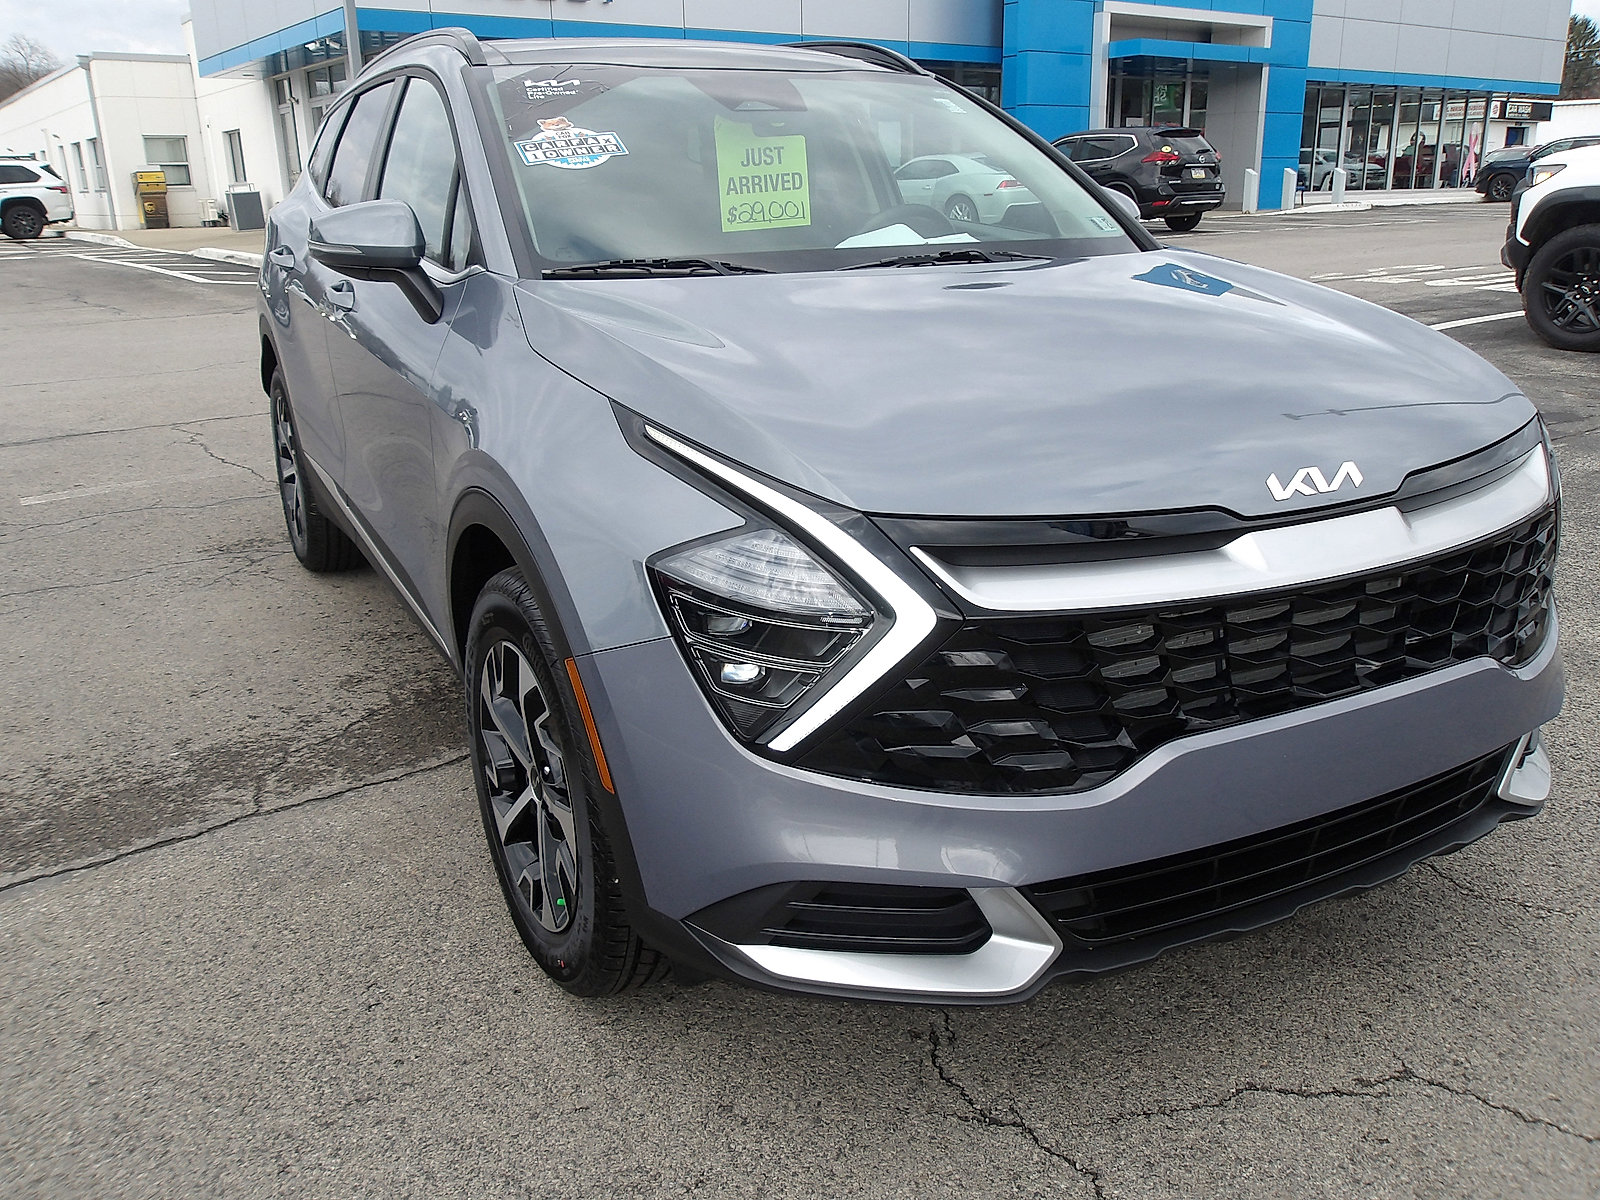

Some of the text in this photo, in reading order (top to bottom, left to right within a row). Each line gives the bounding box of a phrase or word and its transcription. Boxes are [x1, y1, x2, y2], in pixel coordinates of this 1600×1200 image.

[523, 137, 612, 152] CARFAX
[544, 145, 619, 158] OWNER
[740, 146, 785, 167] JUST
[726, 172, 803, 196] ARRIVED
[727, 201, 805, 224] $29,001
